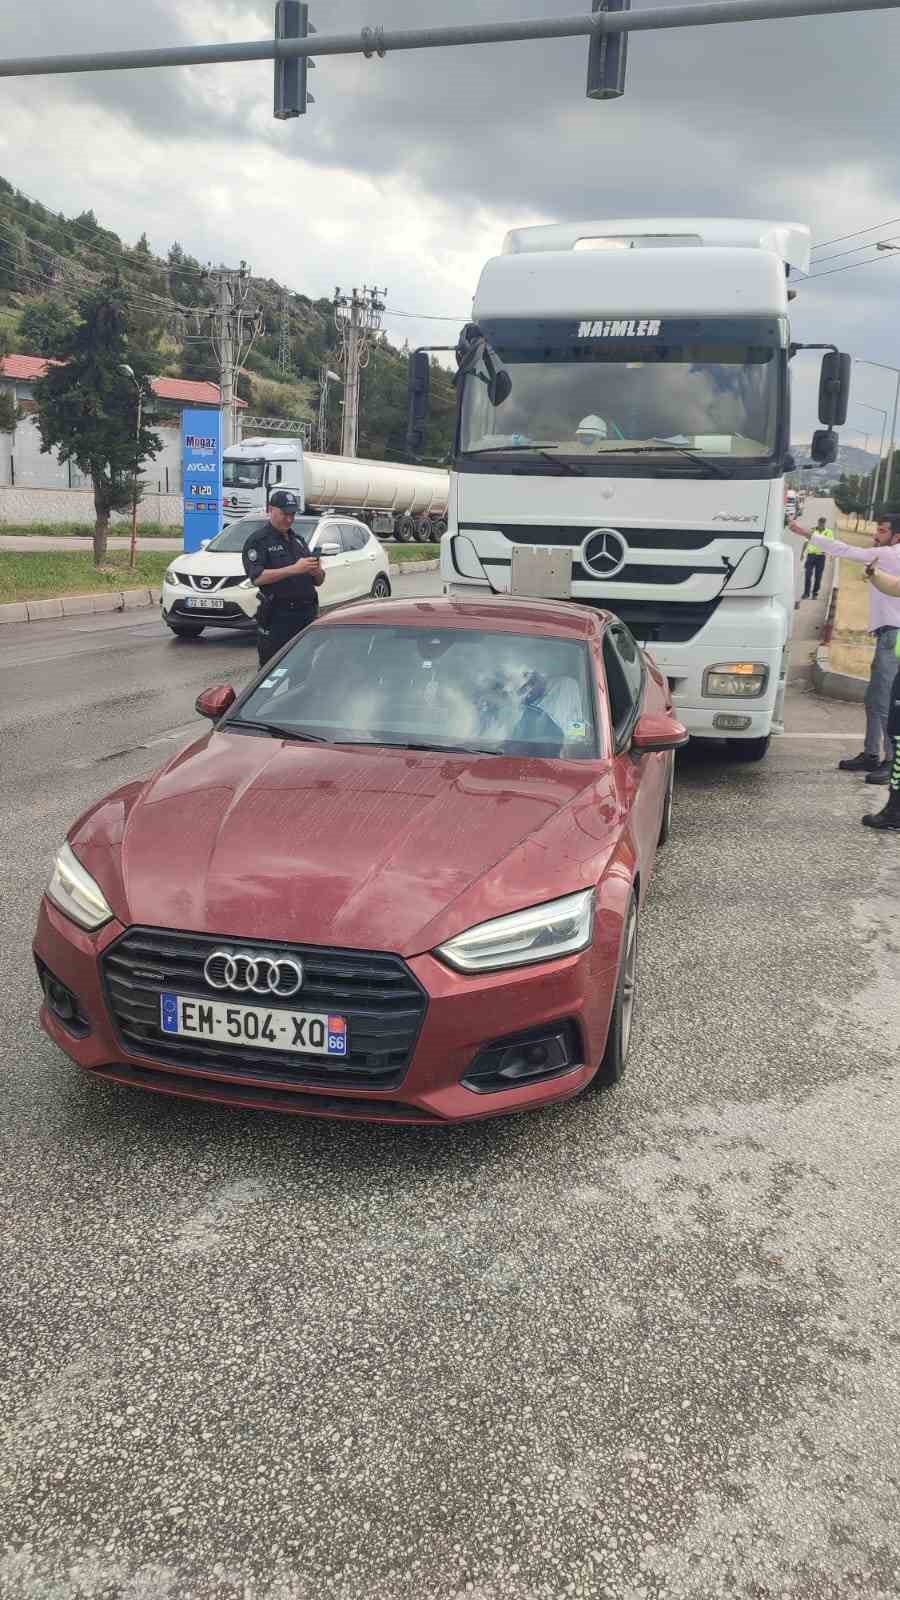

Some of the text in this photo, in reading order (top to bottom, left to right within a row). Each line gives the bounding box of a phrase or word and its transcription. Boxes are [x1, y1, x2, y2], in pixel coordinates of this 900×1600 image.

[187, 463, 216, 472] AYGAZ
[181, 1002, 325, 1048] EM-504-XQ
[328, 1034, 344, 1050] 66
